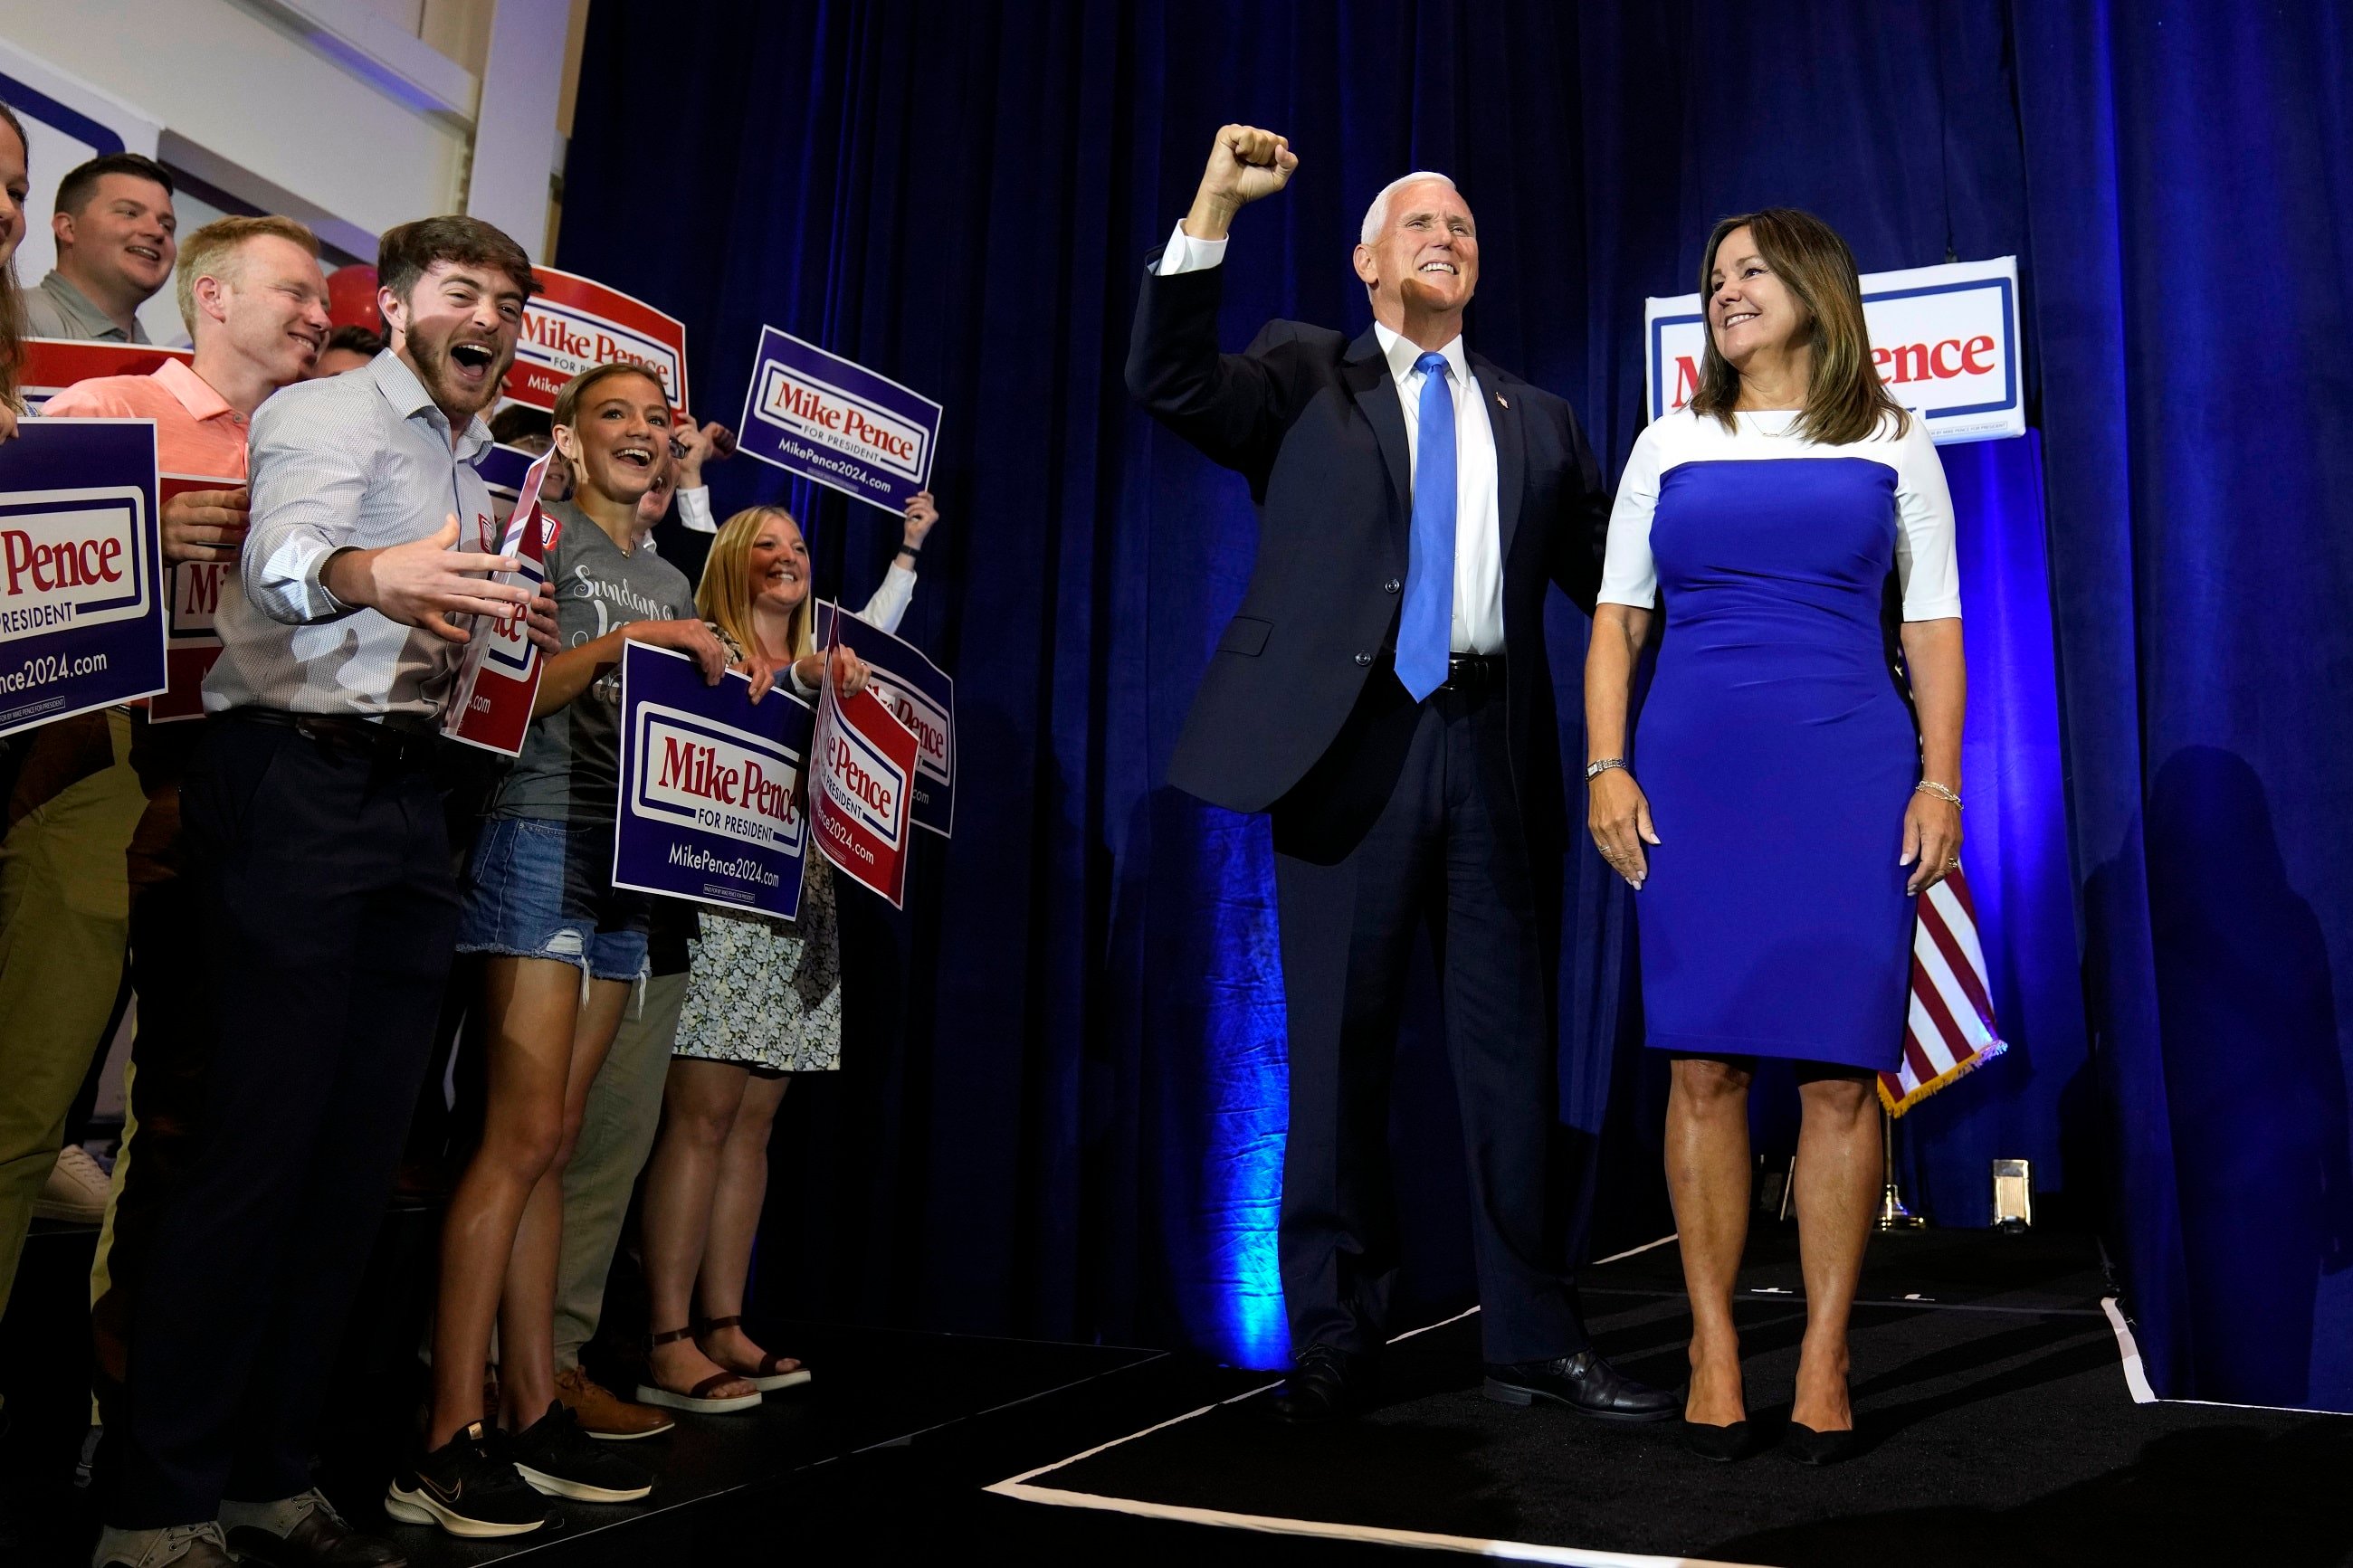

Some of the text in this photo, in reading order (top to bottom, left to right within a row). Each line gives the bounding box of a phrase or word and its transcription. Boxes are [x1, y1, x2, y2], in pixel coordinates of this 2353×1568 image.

[518, 311, 591, 359] Mike
[554, 356, 576, 374] FOR
[1872, 335, 1995, 385] ence
[774, 381, 914, 461] Mike Pence
[803, 424, 881, 463] FOR PRESIDENT
[778, 437, 891, 493] MikePence2024.com
[1, 529, 123, 596] Pence
[0, 602, 72, 633] RESIDENT
[0, 652, 108, 695] nce2024.com
[658, 736, 797, 825] Mike Pence
[826, 775, 862, 819] PRESIDENT
[834, 736, 891, 819] Pence
[698, 808, 774, 843] FOR PRESIDENT
[817, 805, 874, 866] ence2024.com
[668, 842, 779, 888] MikePence2024.com
